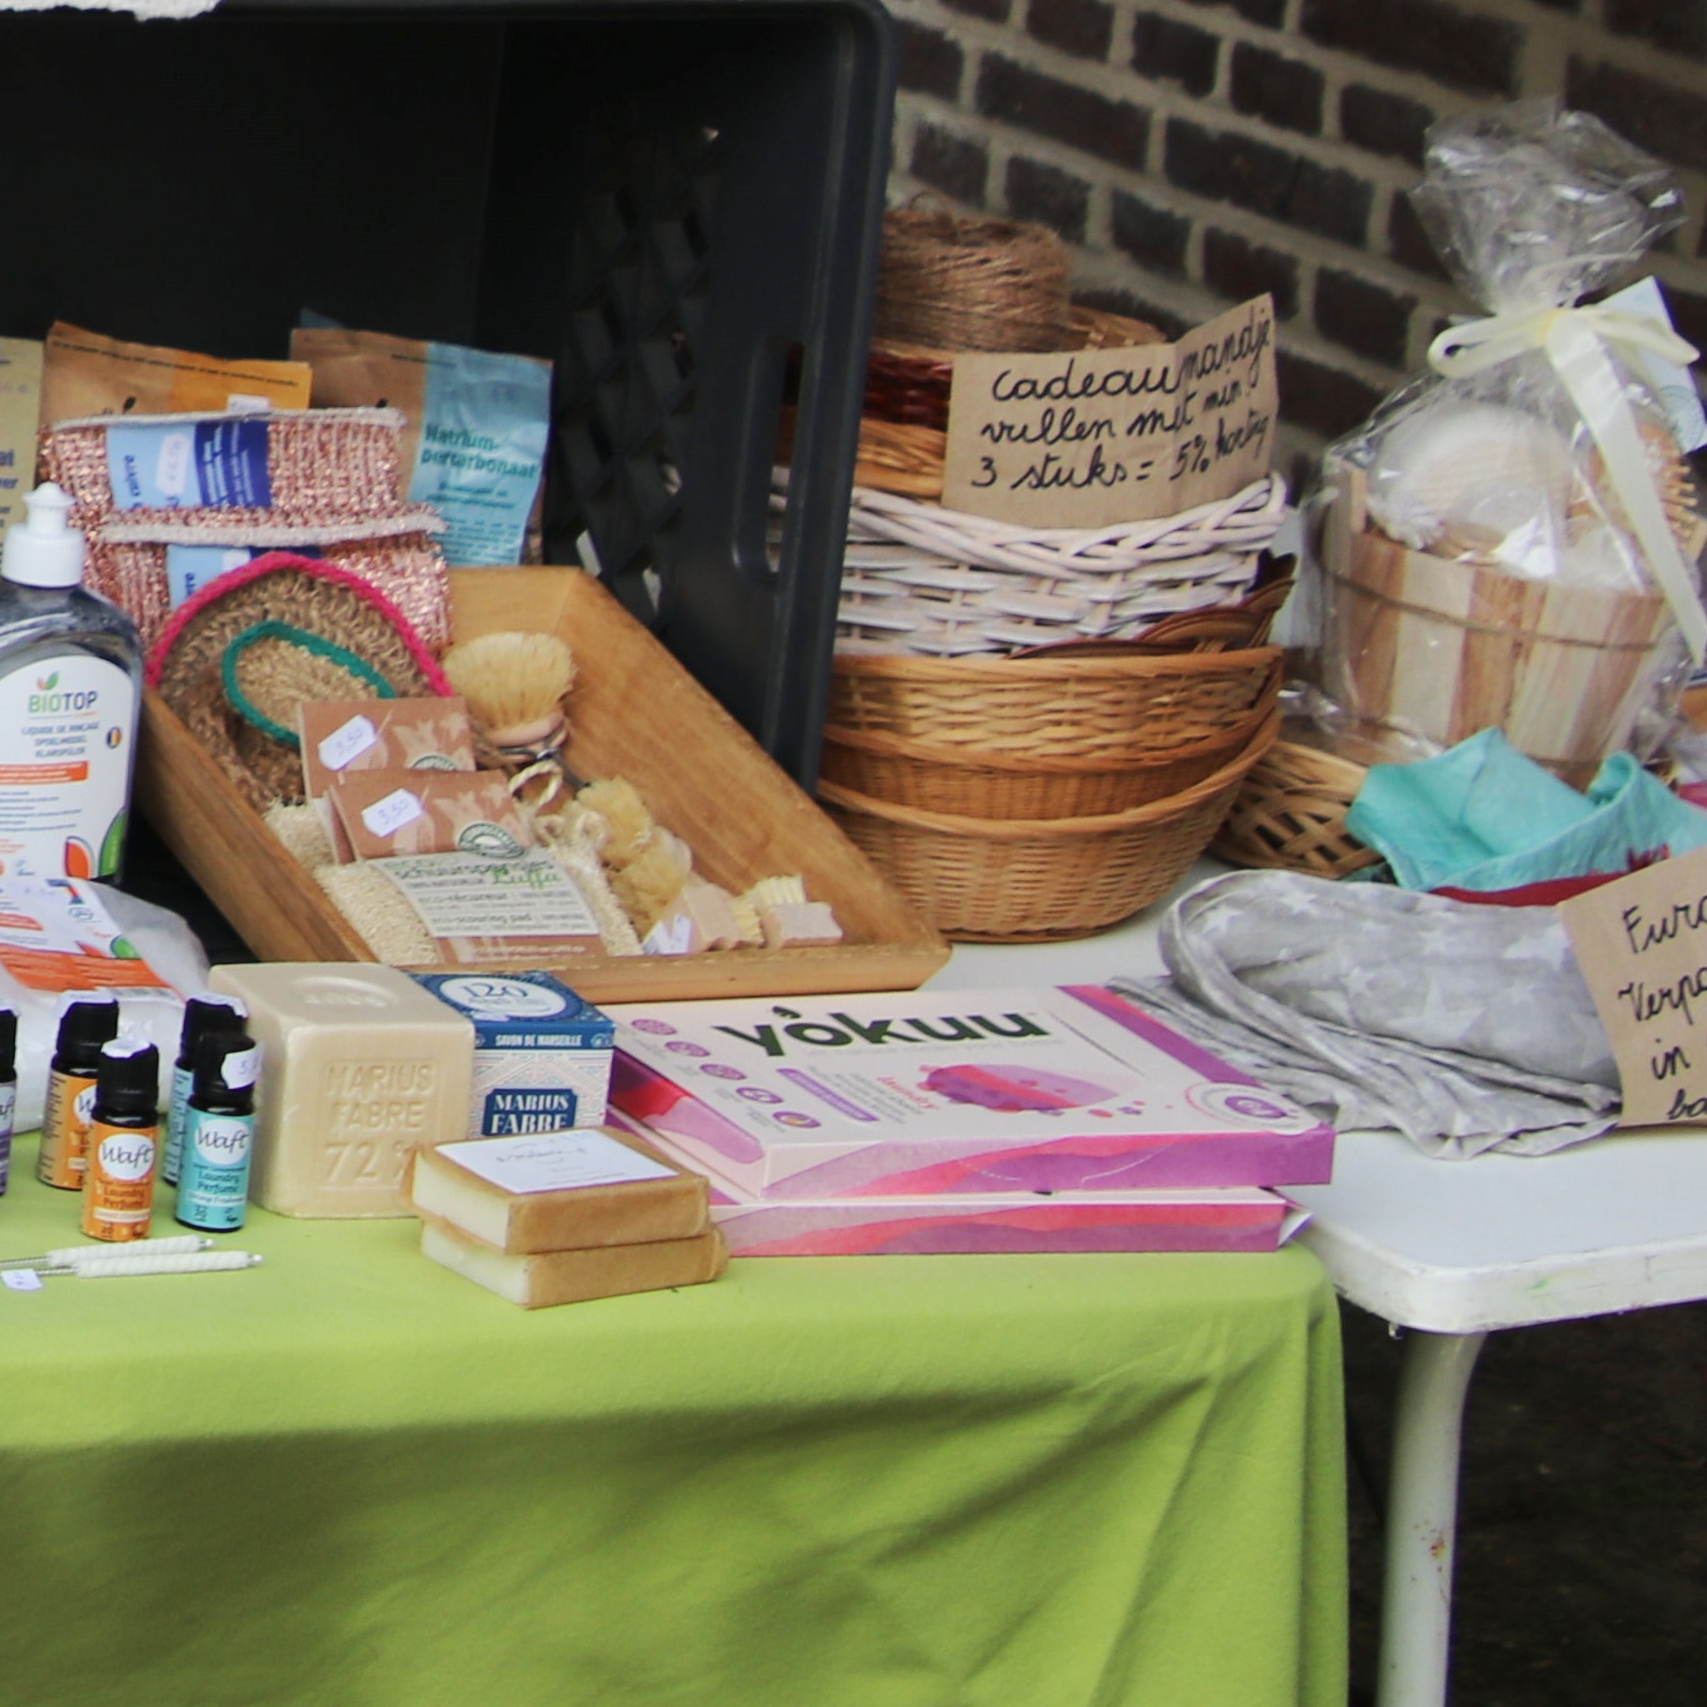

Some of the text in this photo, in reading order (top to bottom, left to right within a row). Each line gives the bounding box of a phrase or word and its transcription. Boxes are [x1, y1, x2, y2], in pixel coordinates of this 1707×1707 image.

[425, 424, 502, 452] Natrium-
[971, 456, 999, 487] 3
[1009, 444, 1130, 490] stuks
[1168, 440, 1212, 482] 5%
[28, 691, 98, 713] BIOTOP
[495, 1034, 582, 1046] SAVON DE MARSEILLE
[1652, 1037, 1690, 1080] in
[326, 1064, 435, 1096] MARIUS
[330, 1098, 426, 1133] FABRE
[493, 1093, 570, 1112] MARIUS
[490, 1113, 568, 1135] FABRE
[197, 1127, 251, 1154] Waft
[100, 1144, 156, 1169] Waft
[326, 1141, 379, 1183] 72
[197, 1170, 241, 1184] Laundry
[197, 1181, 240, 1195] Perfume
